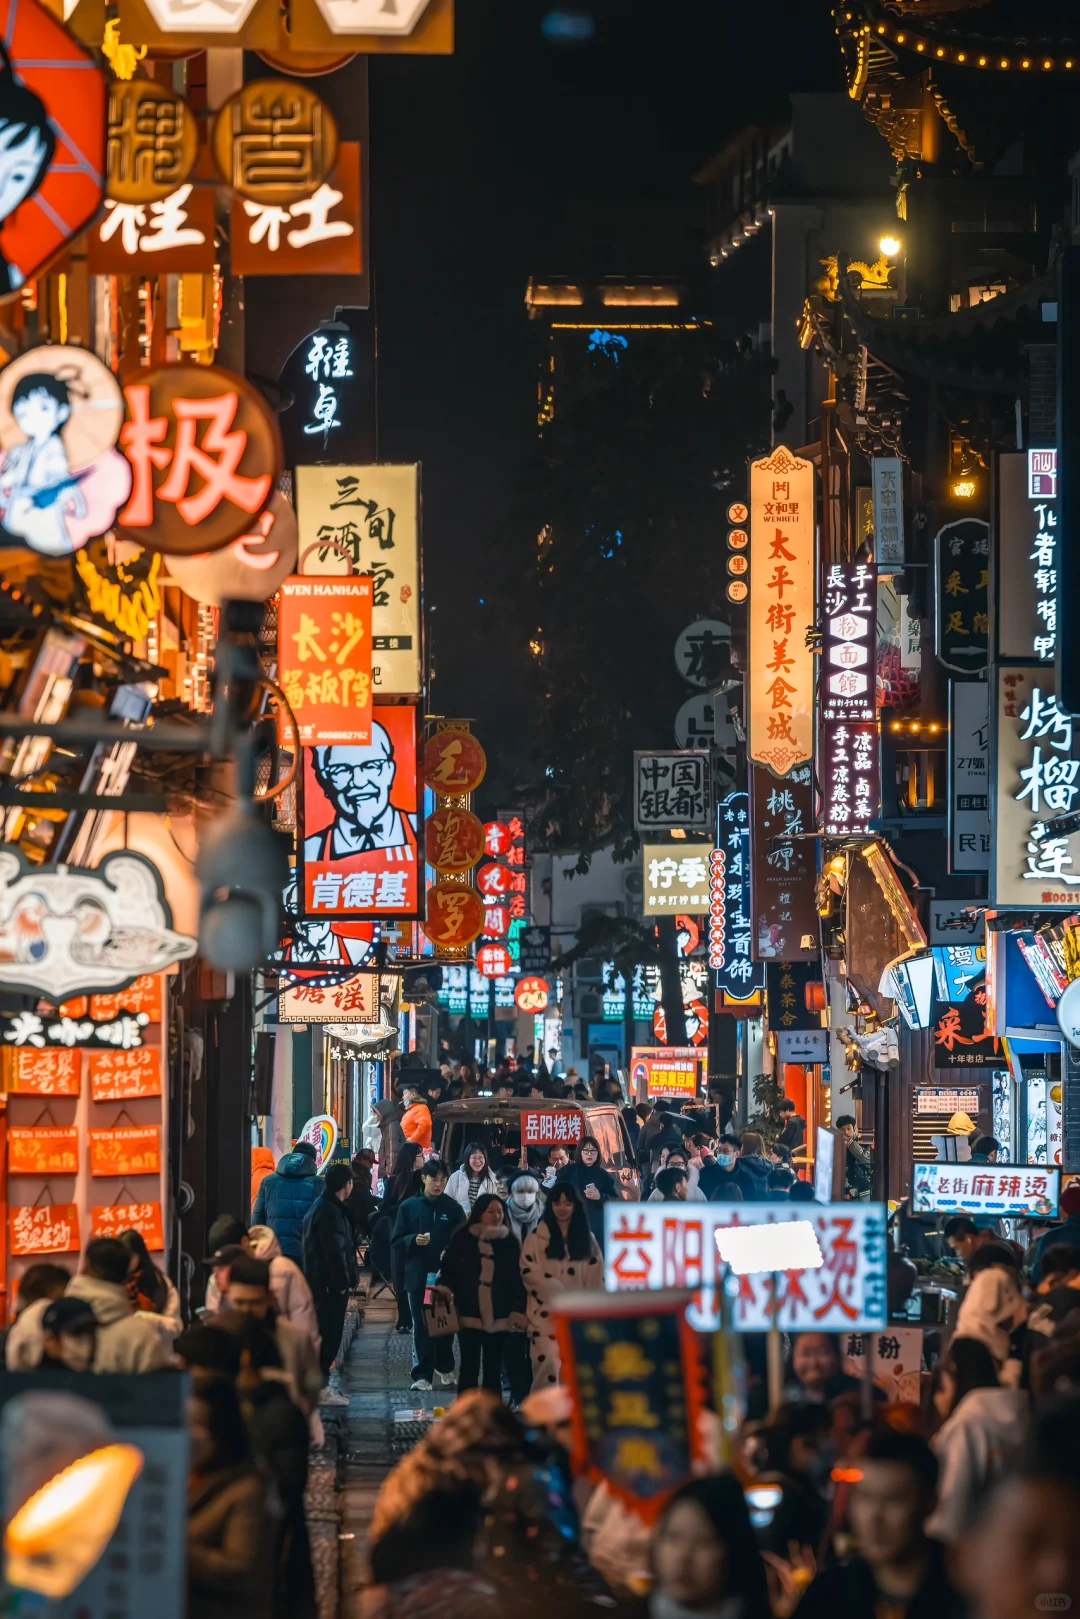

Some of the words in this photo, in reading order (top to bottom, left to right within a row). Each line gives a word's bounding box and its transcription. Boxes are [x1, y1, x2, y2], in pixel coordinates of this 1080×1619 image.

[118, 384, 273, 527] 极
[762, 502, 800, 515] 文和里
[282, 584, 311, 597] WEN
[313, 584, 370, 597] HANHAN
[826, 564, 848, 616] 長沙
[850, 564, 873, 612] 手工
[291, 612, 364, 665] 长沙
[765, 528, 798, 746] 太平街美食城
[640, 758, 701, 791] 中国
[648, 856, 707, 889] 柠季
[312, 870, 410, 910] 肯德基
[947, 1054, 985, 1064] 十年老店
[525, 1114, 582, 1142] 岳阳烧烤
[937, 1173, 1047, 1199] 老街麻辣烫
